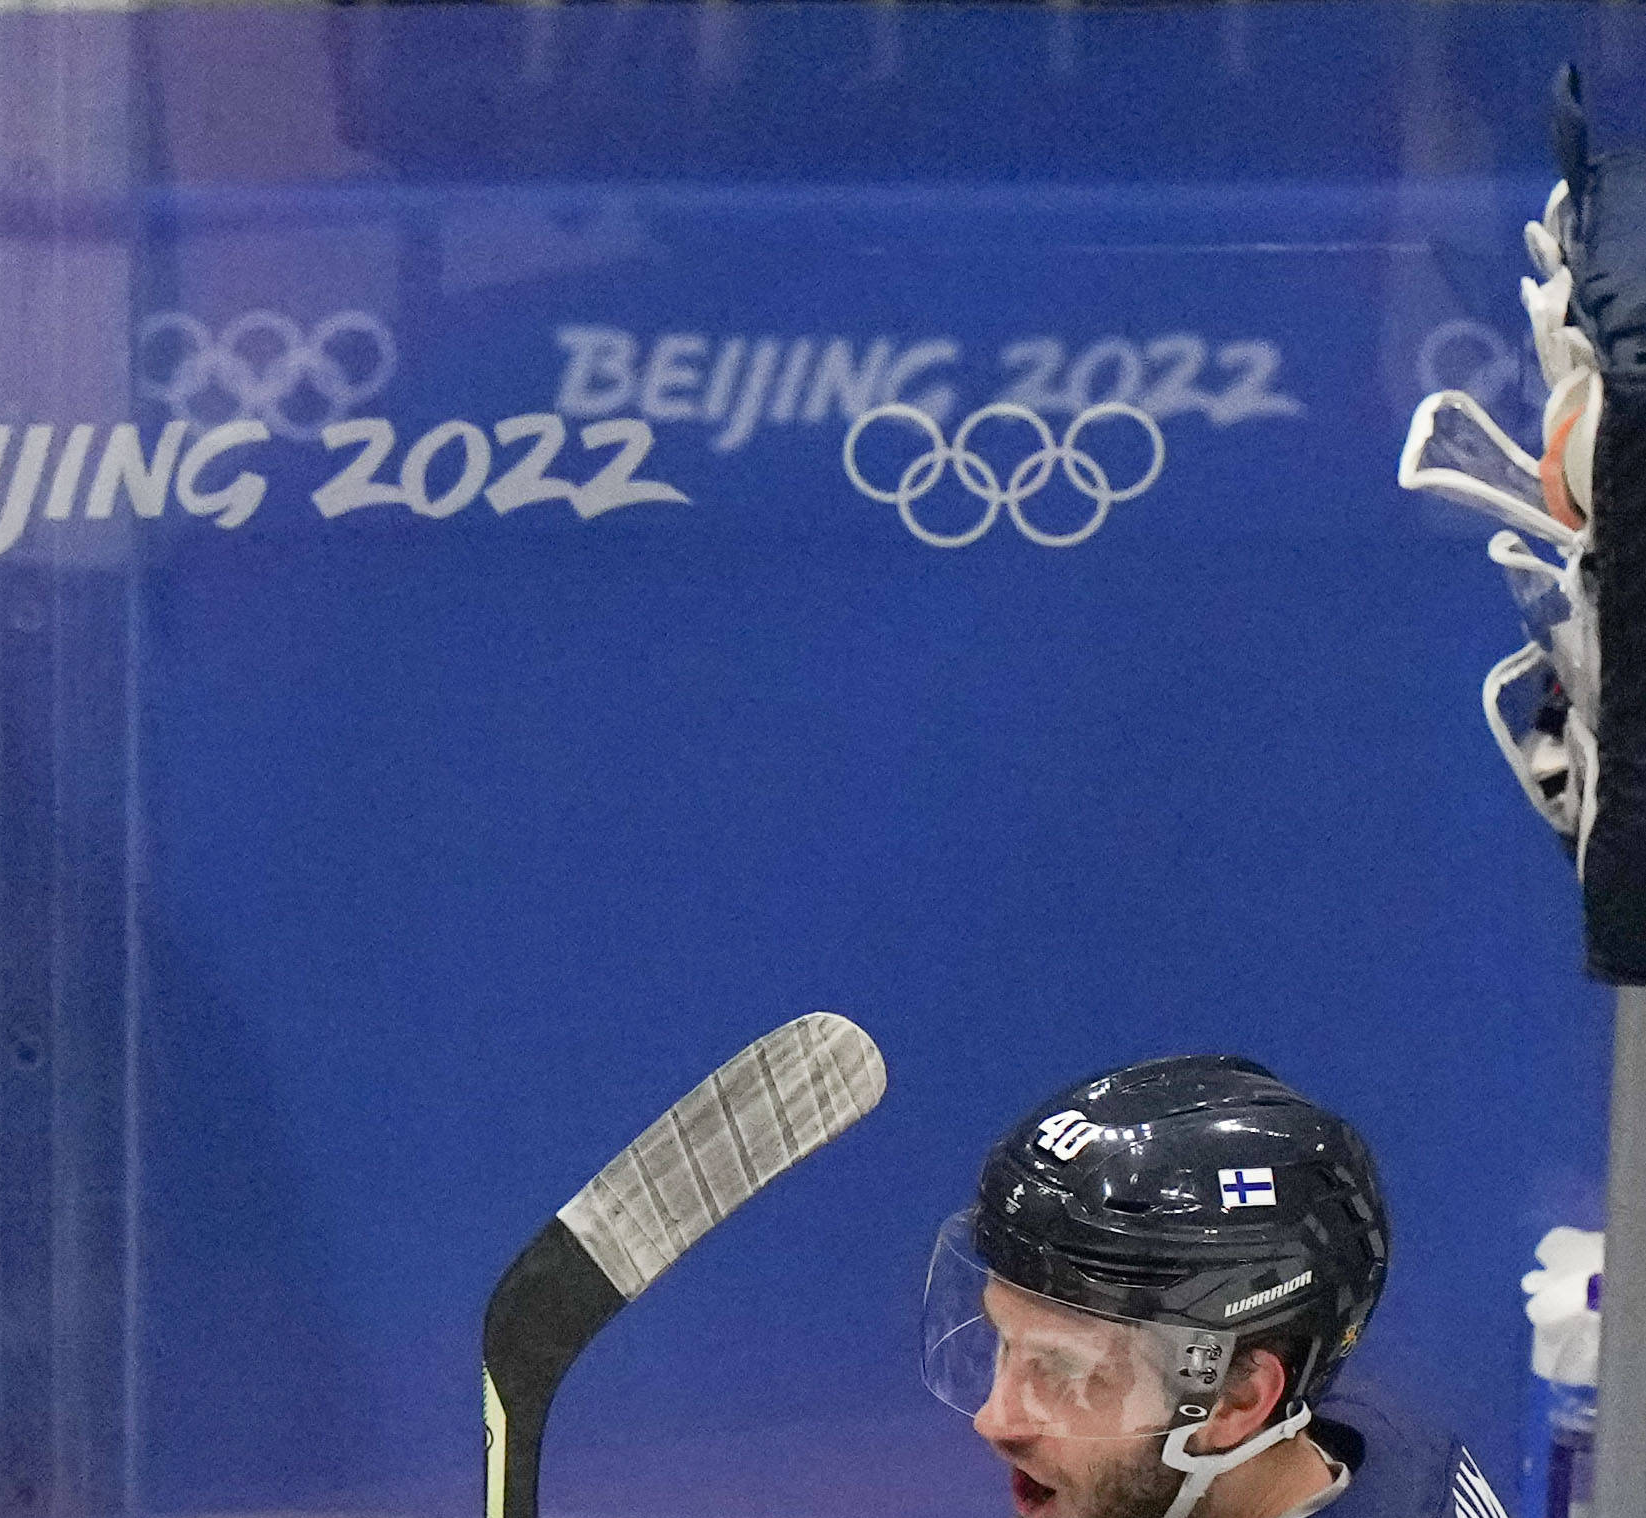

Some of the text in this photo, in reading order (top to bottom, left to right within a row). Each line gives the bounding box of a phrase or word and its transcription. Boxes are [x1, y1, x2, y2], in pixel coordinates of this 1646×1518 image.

[555, 327, 1303, 452] BEIJING 2022
[311, 415, 693, 520] 2022
[1036, 1109, 1098, 1160] 40
[1223, 1268, 1314, 1319] WARRIOR
